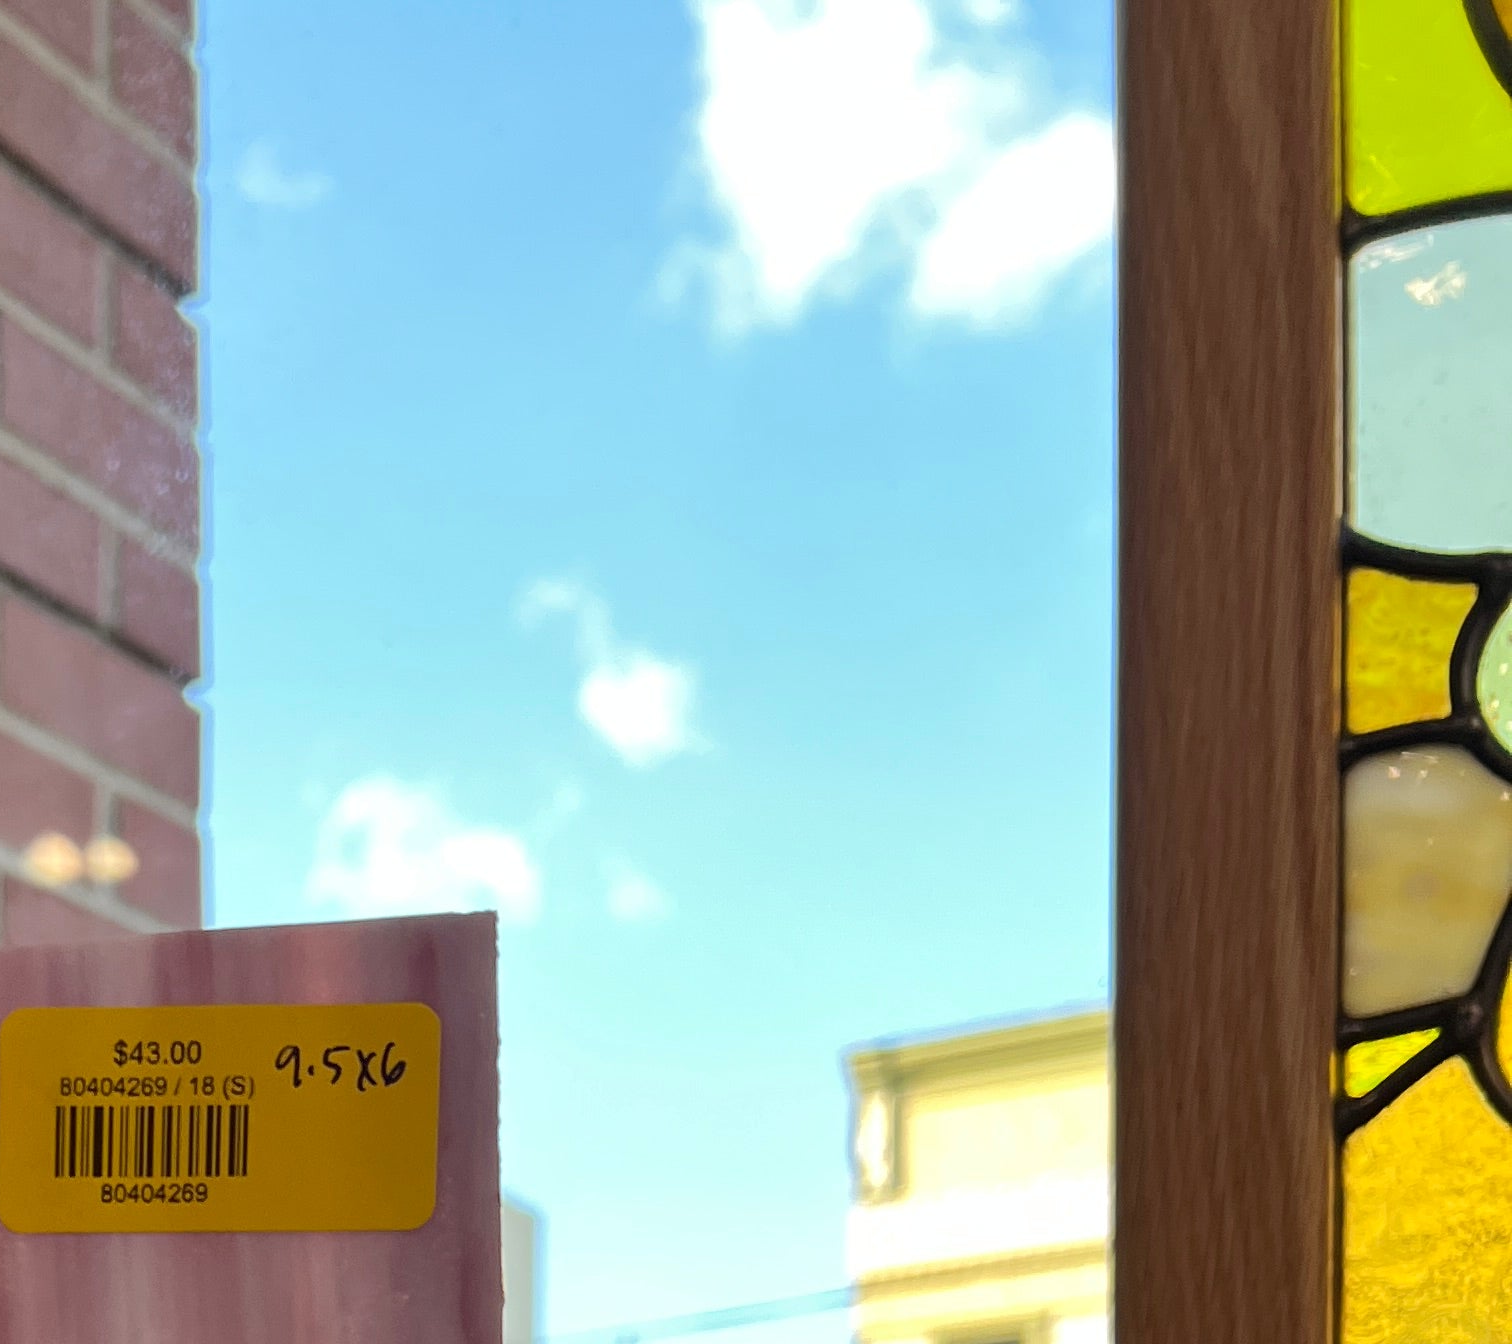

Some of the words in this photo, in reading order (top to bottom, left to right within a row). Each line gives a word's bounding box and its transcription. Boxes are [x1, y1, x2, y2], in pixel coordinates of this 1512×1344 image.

[113, 1039, 202, 1068] $43.00
[59, 1076, 168, 1098] 80404269
[173, 1076, 182, 1097] /
[189, 1076, 216, 1097] 18
[223, 1075, 256, 1100] (S)
[100, 1183, 209, 1205] 80404269
